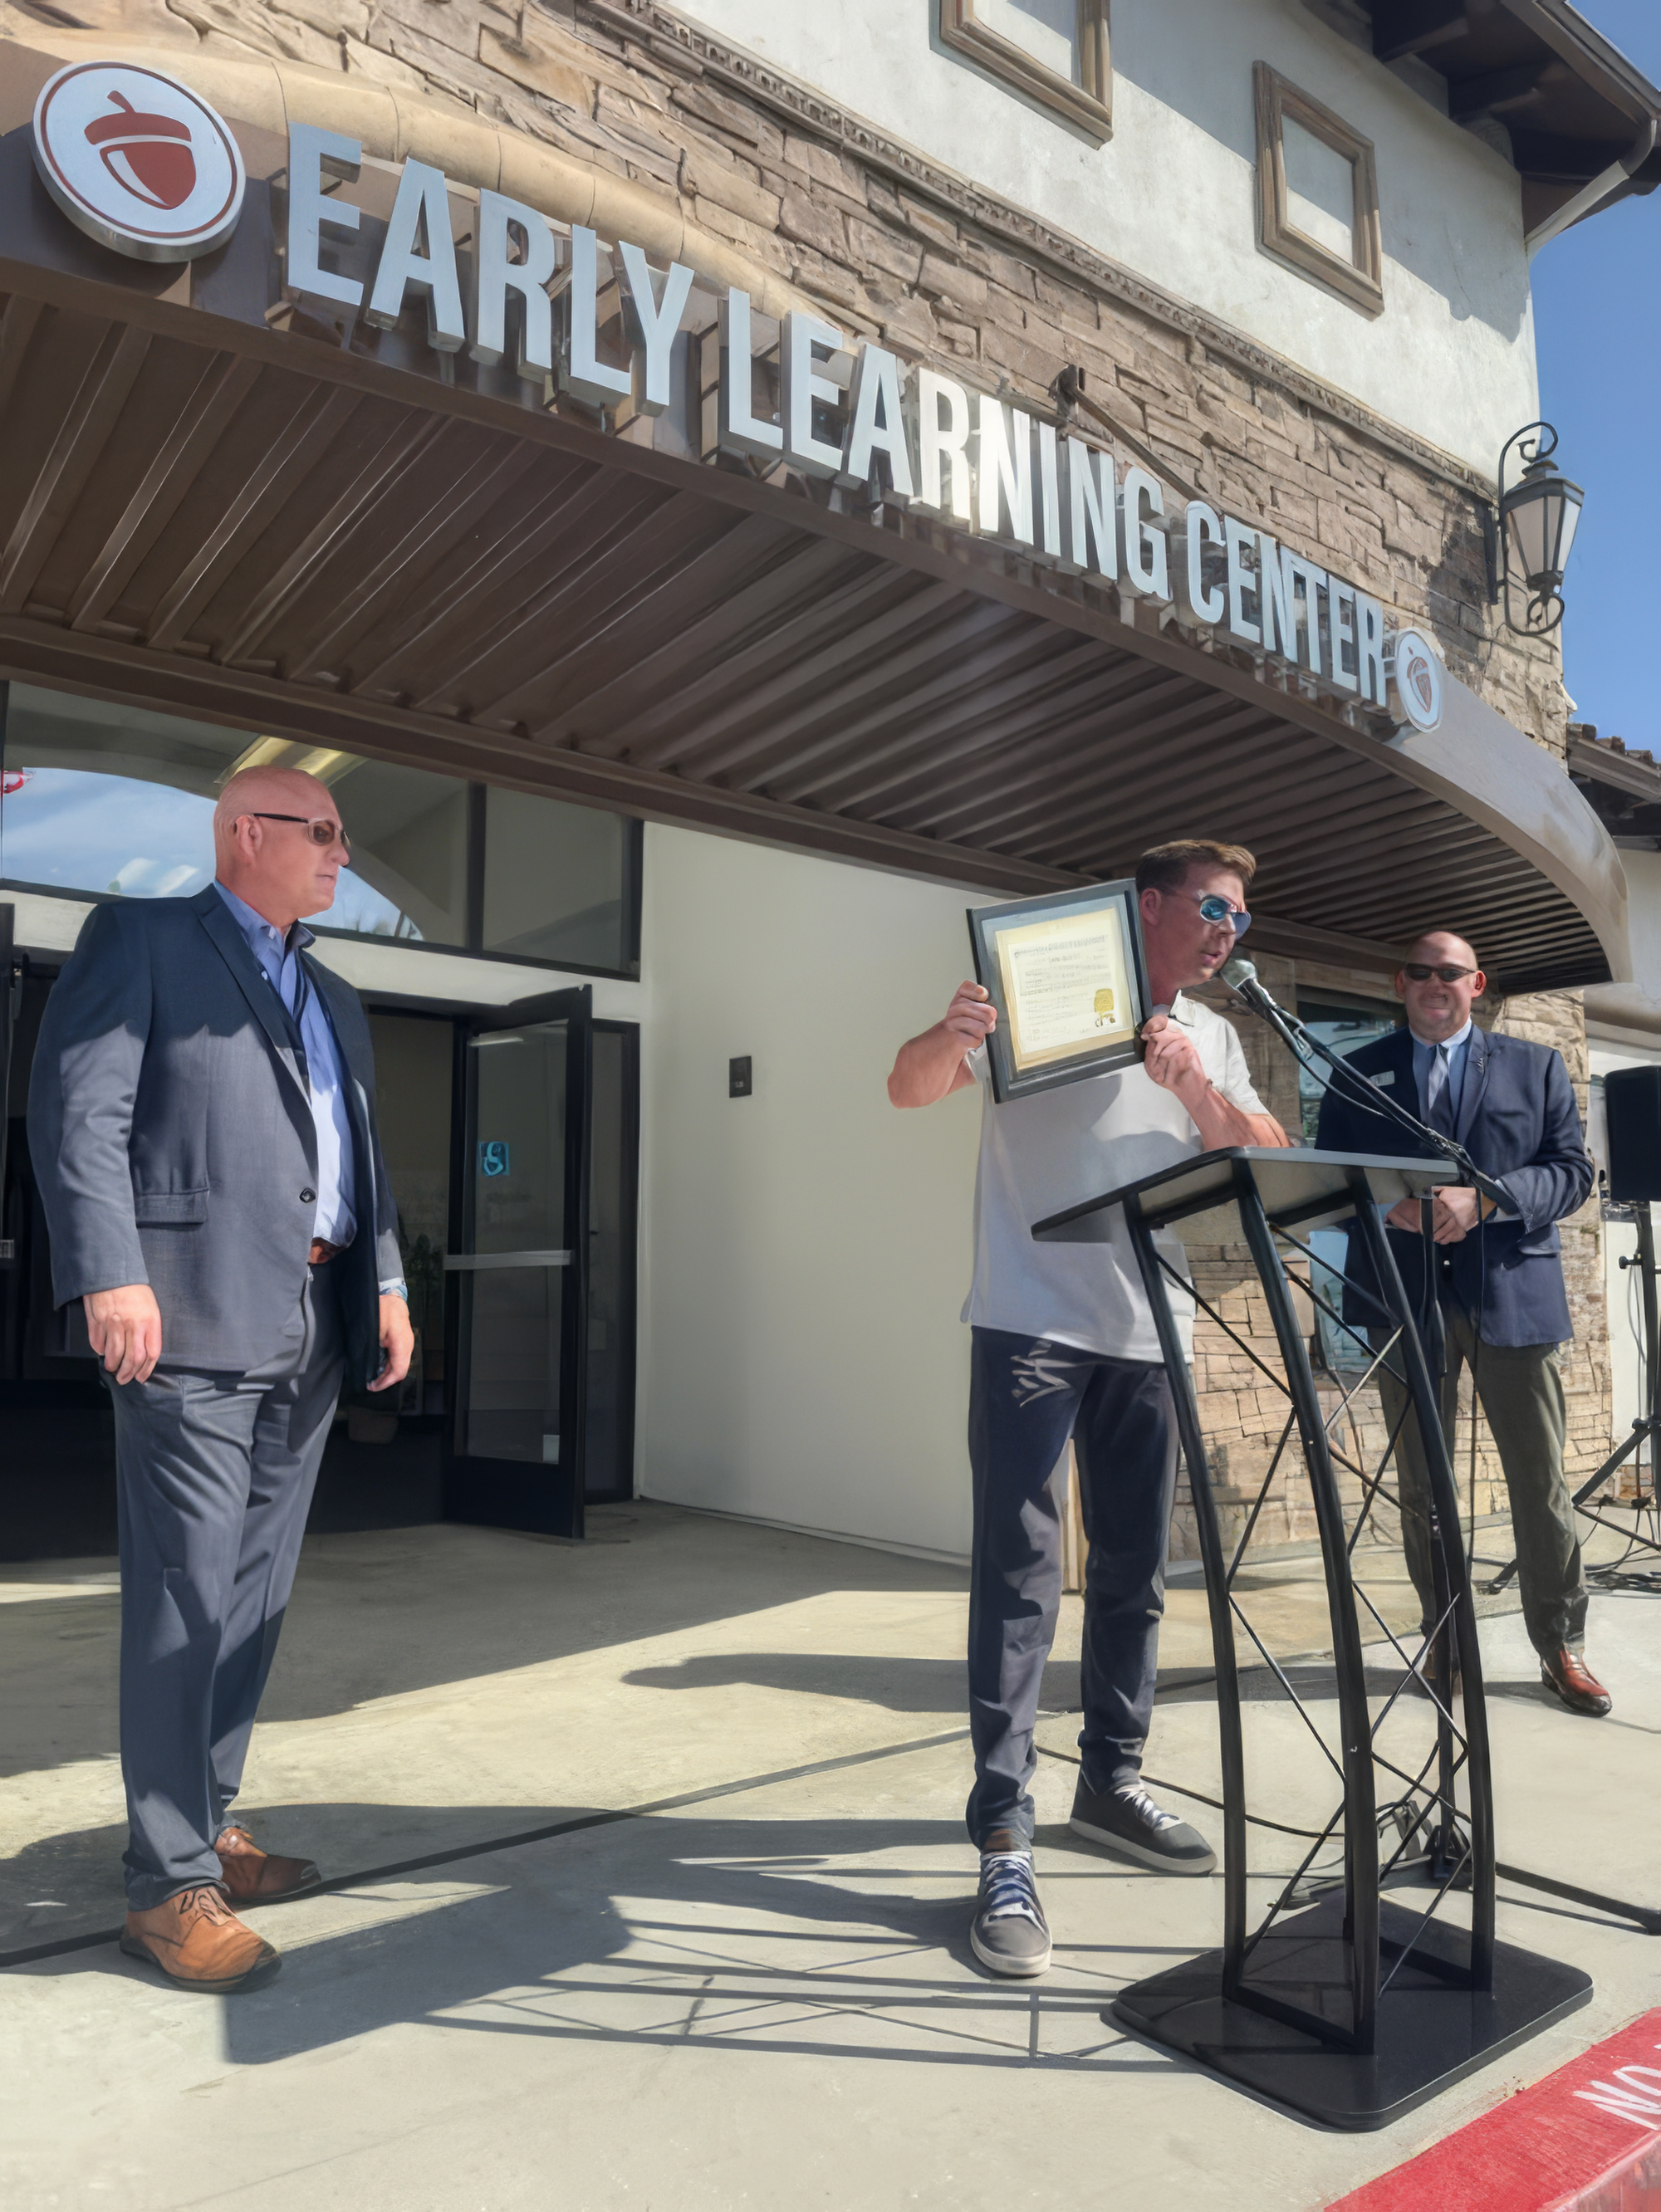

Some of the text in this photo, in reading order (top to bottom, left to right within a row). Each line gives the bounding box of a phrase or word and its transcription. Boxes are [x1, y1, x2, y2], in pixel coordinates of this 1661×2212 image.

[287, 121, 1386, 707] EARLY LEARNING CENTER
